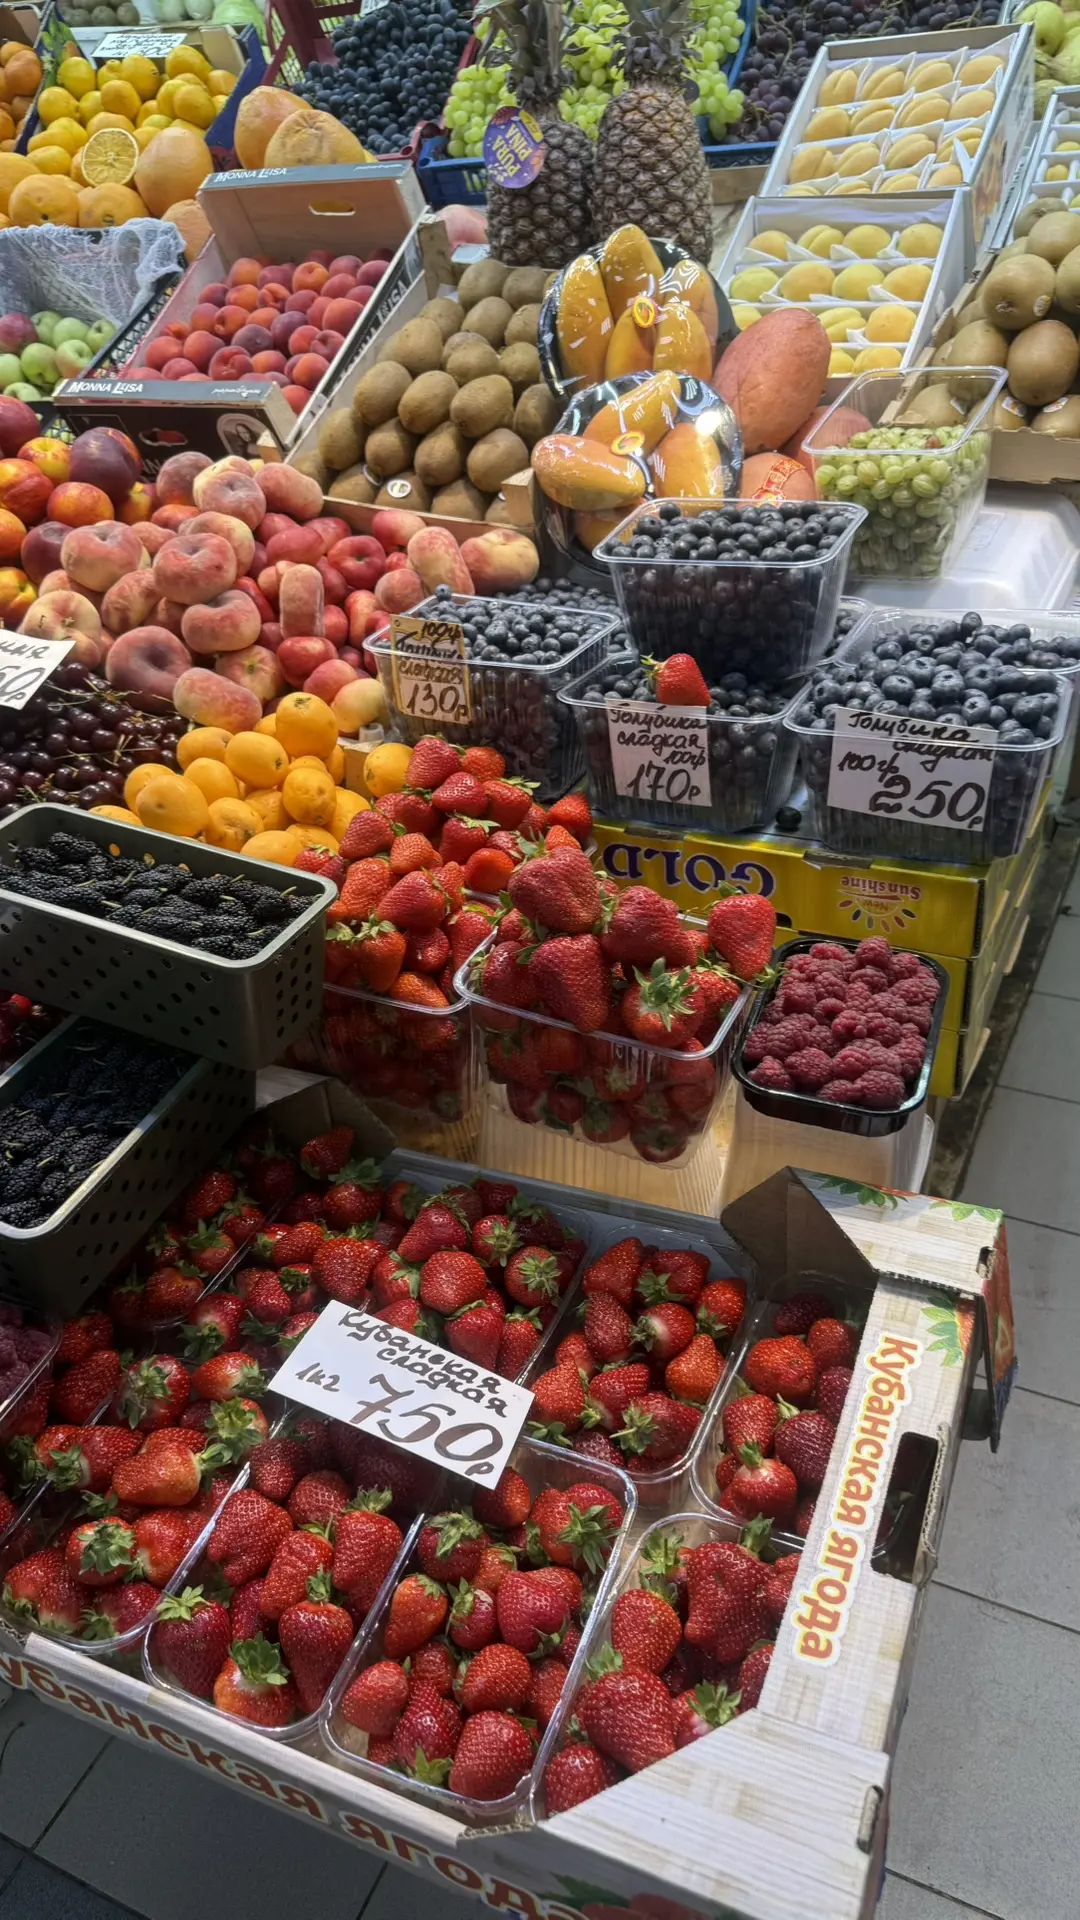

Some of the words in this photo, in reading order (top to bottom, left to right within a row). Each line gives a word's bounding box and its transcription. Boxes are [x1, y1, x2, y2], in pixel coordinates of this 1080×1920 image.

[492, 135, 521, 178] PURA
[213, 171, 257, 183] MONNA
[67, 381, 112, 393] MONNA
[610, 702, 707, 733] Голубика
[848, 711, 980, 744] Голубика
[617, 730, 706, 757] сладкая
[602, 843, 775, 898] GOLD
[841, 876, 922, 901] Sunshine
[863, 899, 890, 913] New
[338, 1310, 502, 1395] Кубанская
[376, 1347, 508, 1419] сладкая
[835, 1336, 919, 1526] Кубанская
[799, 1531, 859, 1660] ягода
